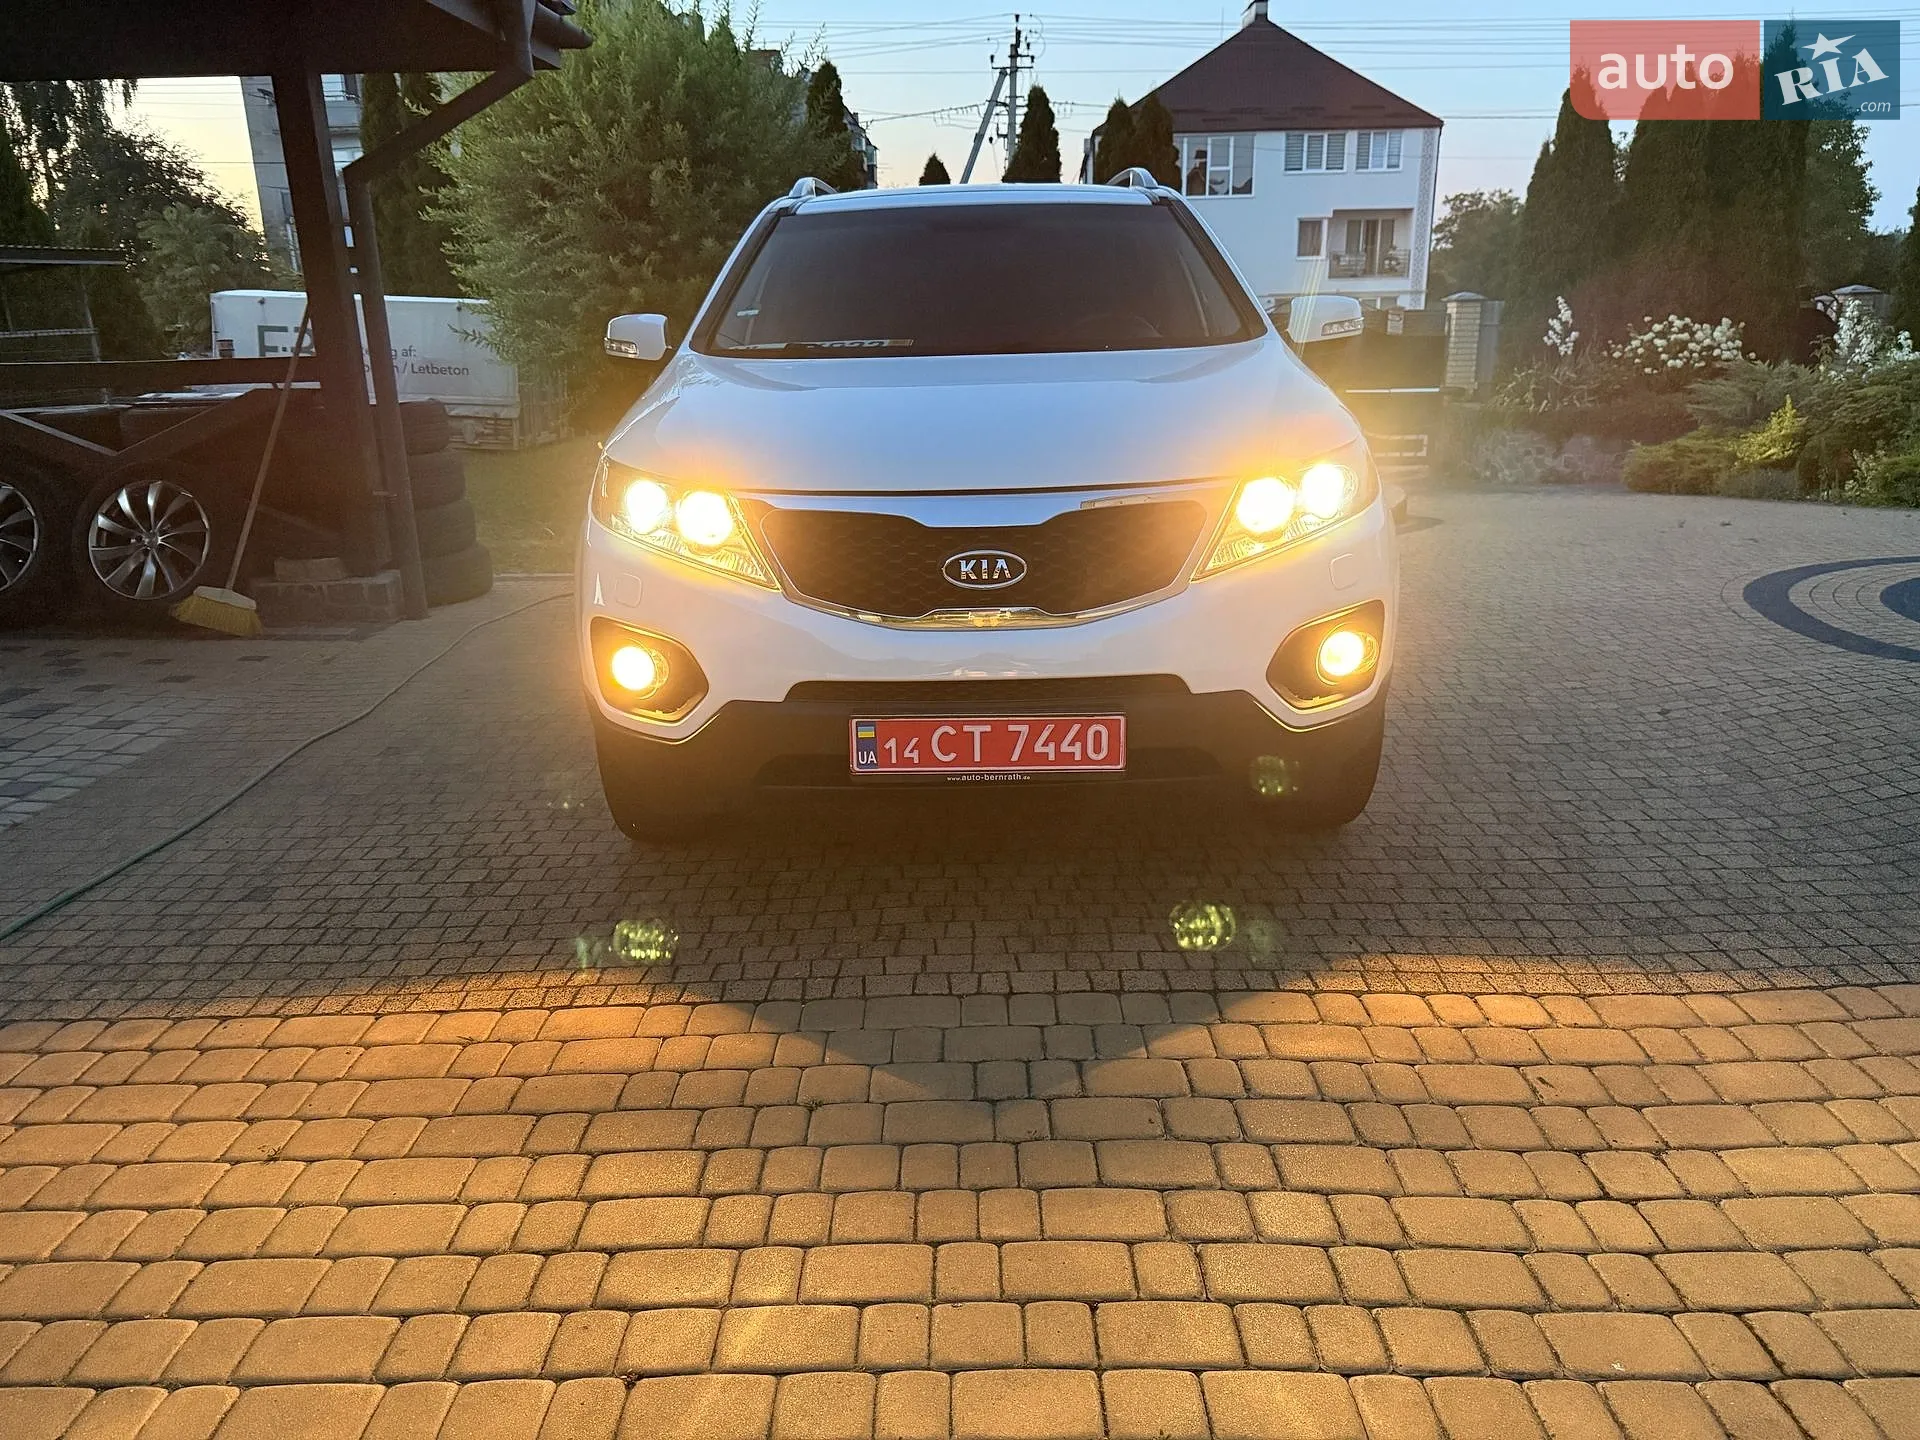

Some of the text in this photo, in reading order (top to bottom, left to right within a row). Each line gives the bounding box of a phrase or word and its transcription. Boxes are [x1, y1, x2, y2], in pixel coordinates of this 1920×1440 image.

[411, 362, 470, 376] Letbeton
[959, 558, 1012, 580] KIA
[884, 723, 1109, 764] 14 CT 7440
[858, 751, 877, 765] UA
[946, 773, 1031, 781] www.auto-bernrath.de
